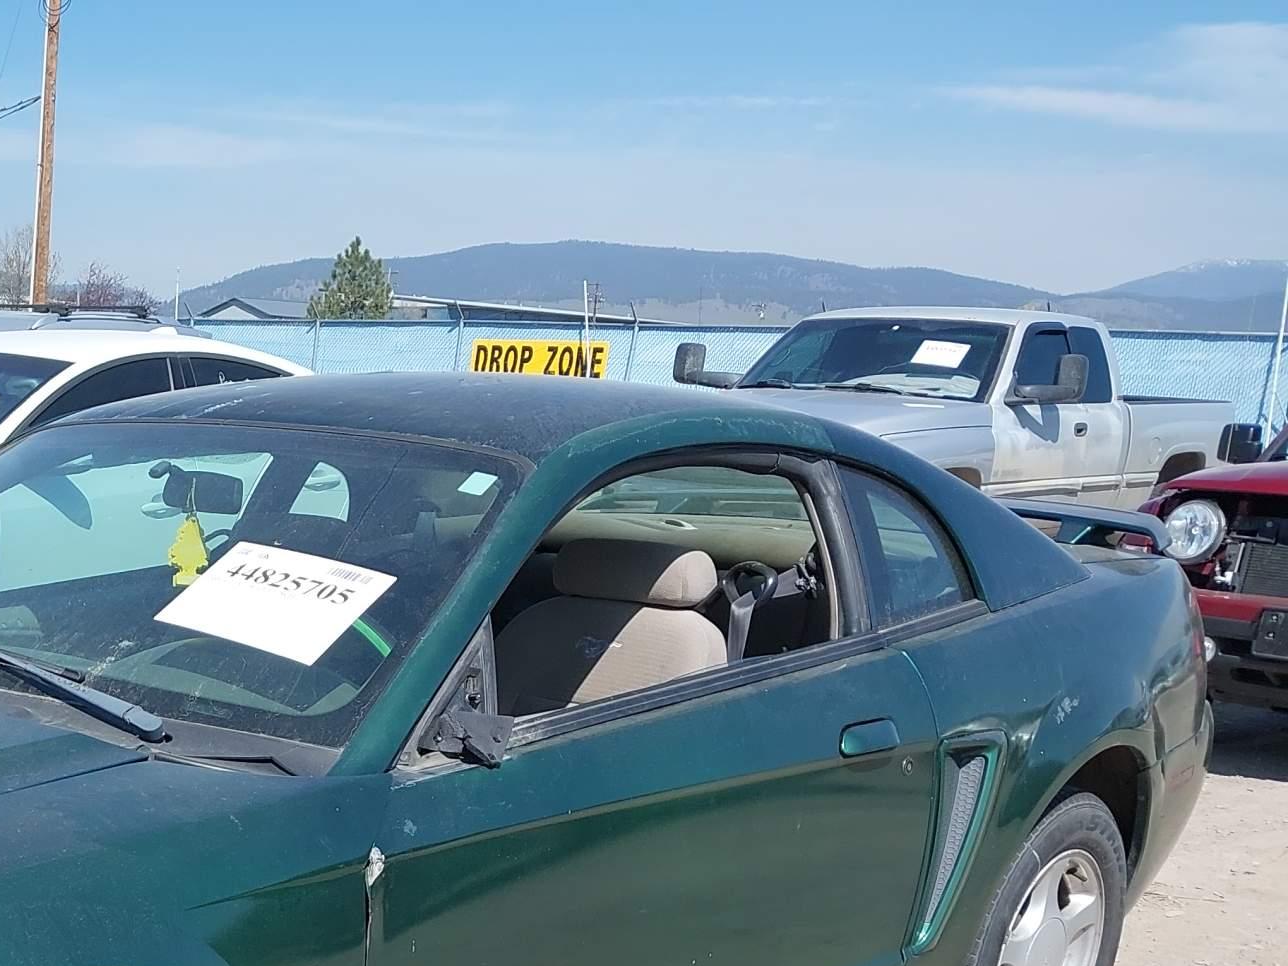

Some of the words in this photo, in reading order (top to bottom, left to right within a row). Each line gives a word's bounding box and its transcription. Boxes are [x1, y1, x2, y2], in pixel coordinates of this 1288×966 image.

[473, 344, 534, 374] DROP
[543, 345, 605, 379] ZONE
[226, 563, 357, 605] 44825705
